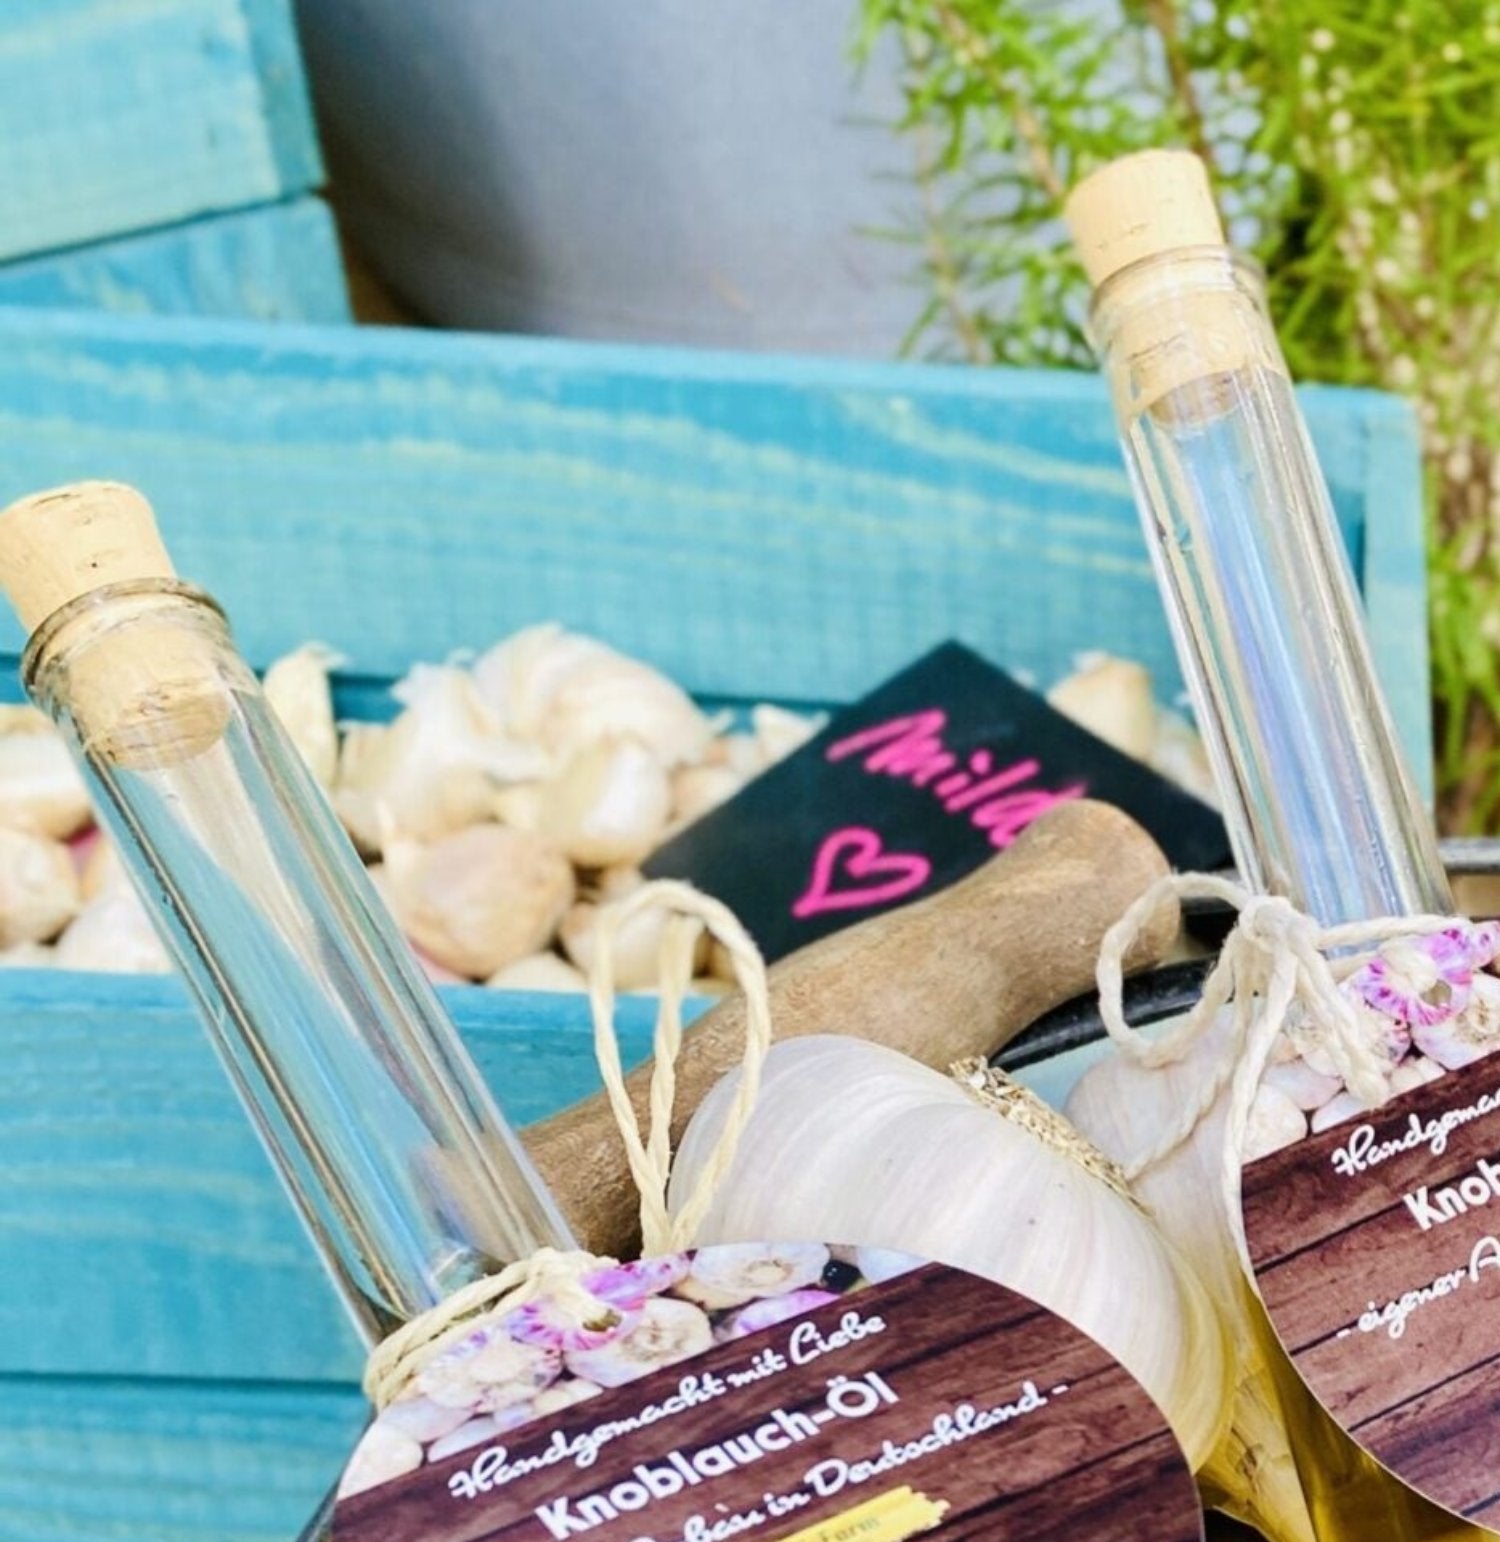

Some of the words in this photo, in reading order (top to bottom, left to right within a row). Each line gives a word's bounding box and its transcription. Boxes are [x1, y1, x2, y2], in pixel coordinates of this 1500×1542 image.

[1358, 1268, 1466, 1338] eigener
[448, 1373, 726, 1500] Handgemacht
[728, 1349, 788, 1388] mit
[790, 1312, 886, 1364] Liebe
[535, 1372, 900, 1541] Knoblauch-Öl
[764, 1490, 811, 1517] in
[804, 1381, 1048, 1498] Deutschland
